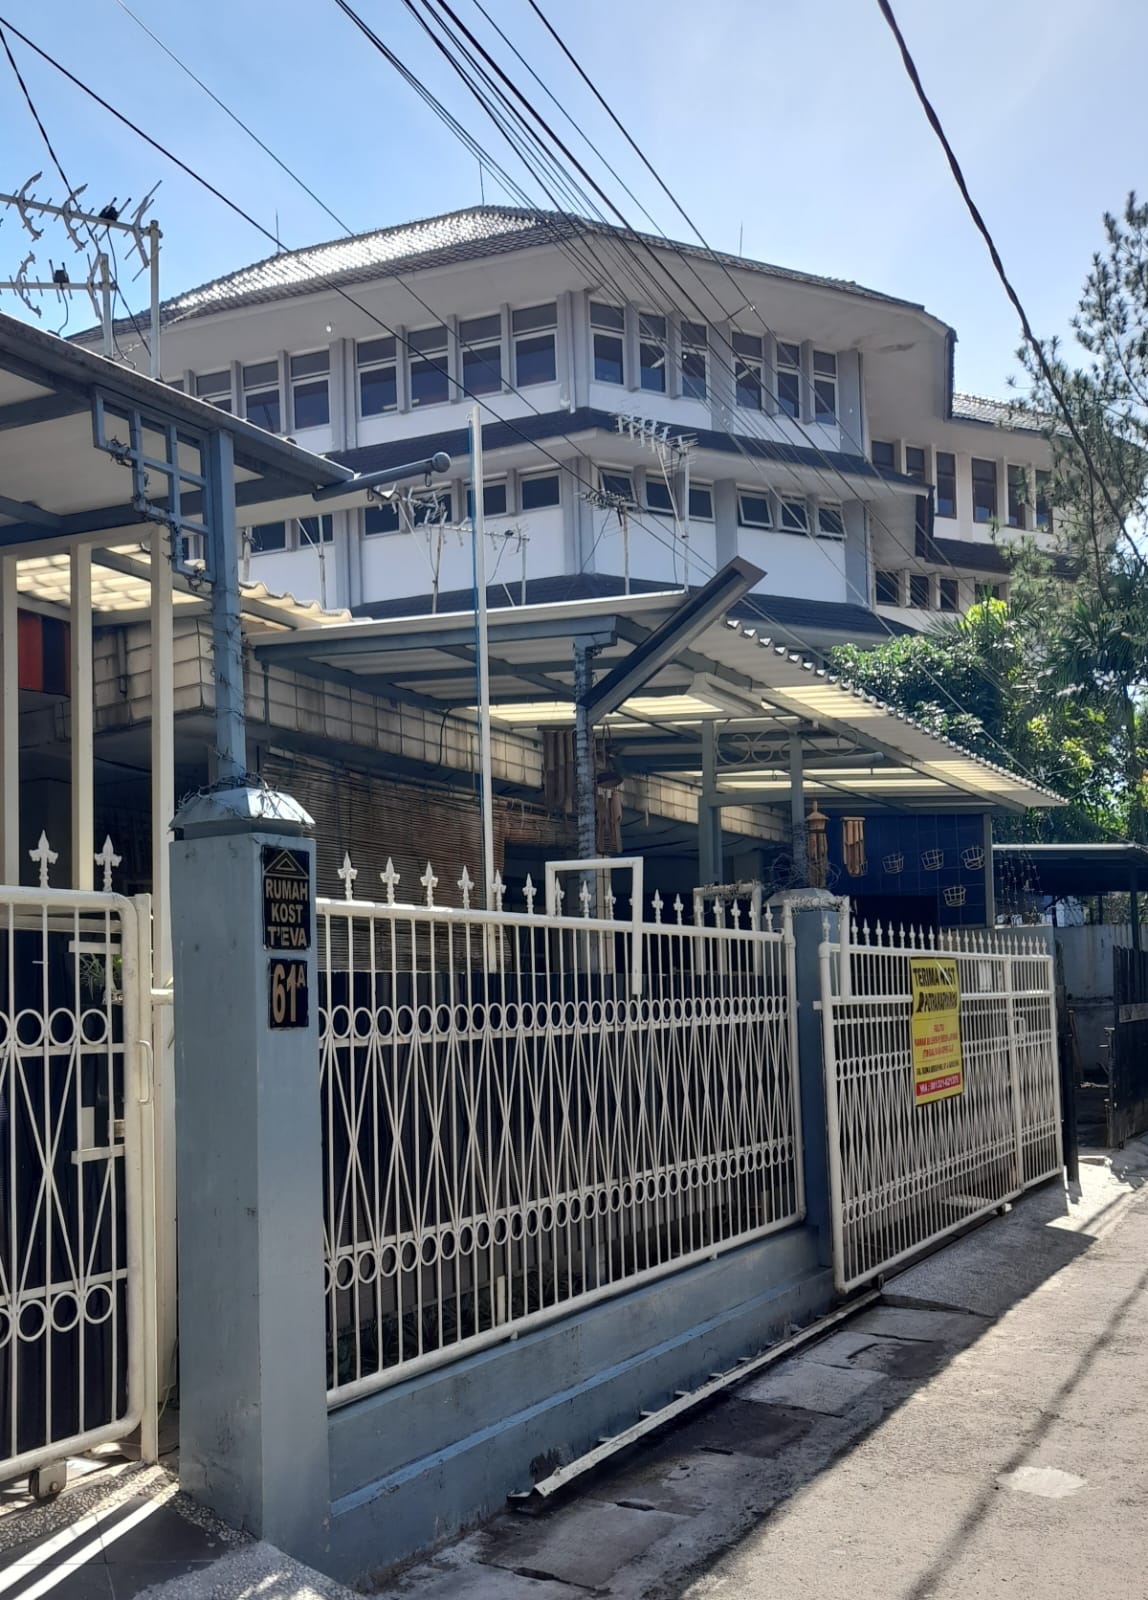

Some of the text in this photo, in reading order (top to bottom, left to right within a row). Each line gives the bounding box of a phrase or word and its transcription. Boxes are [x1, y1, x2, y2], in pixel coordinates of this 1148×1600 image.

[265, 878, 308, 902] RUMAH
[271, 902, 303, 924] KOST
[268, 925, 307, 947] T'EVA
[913, 967, 940, 987] TERIMA
